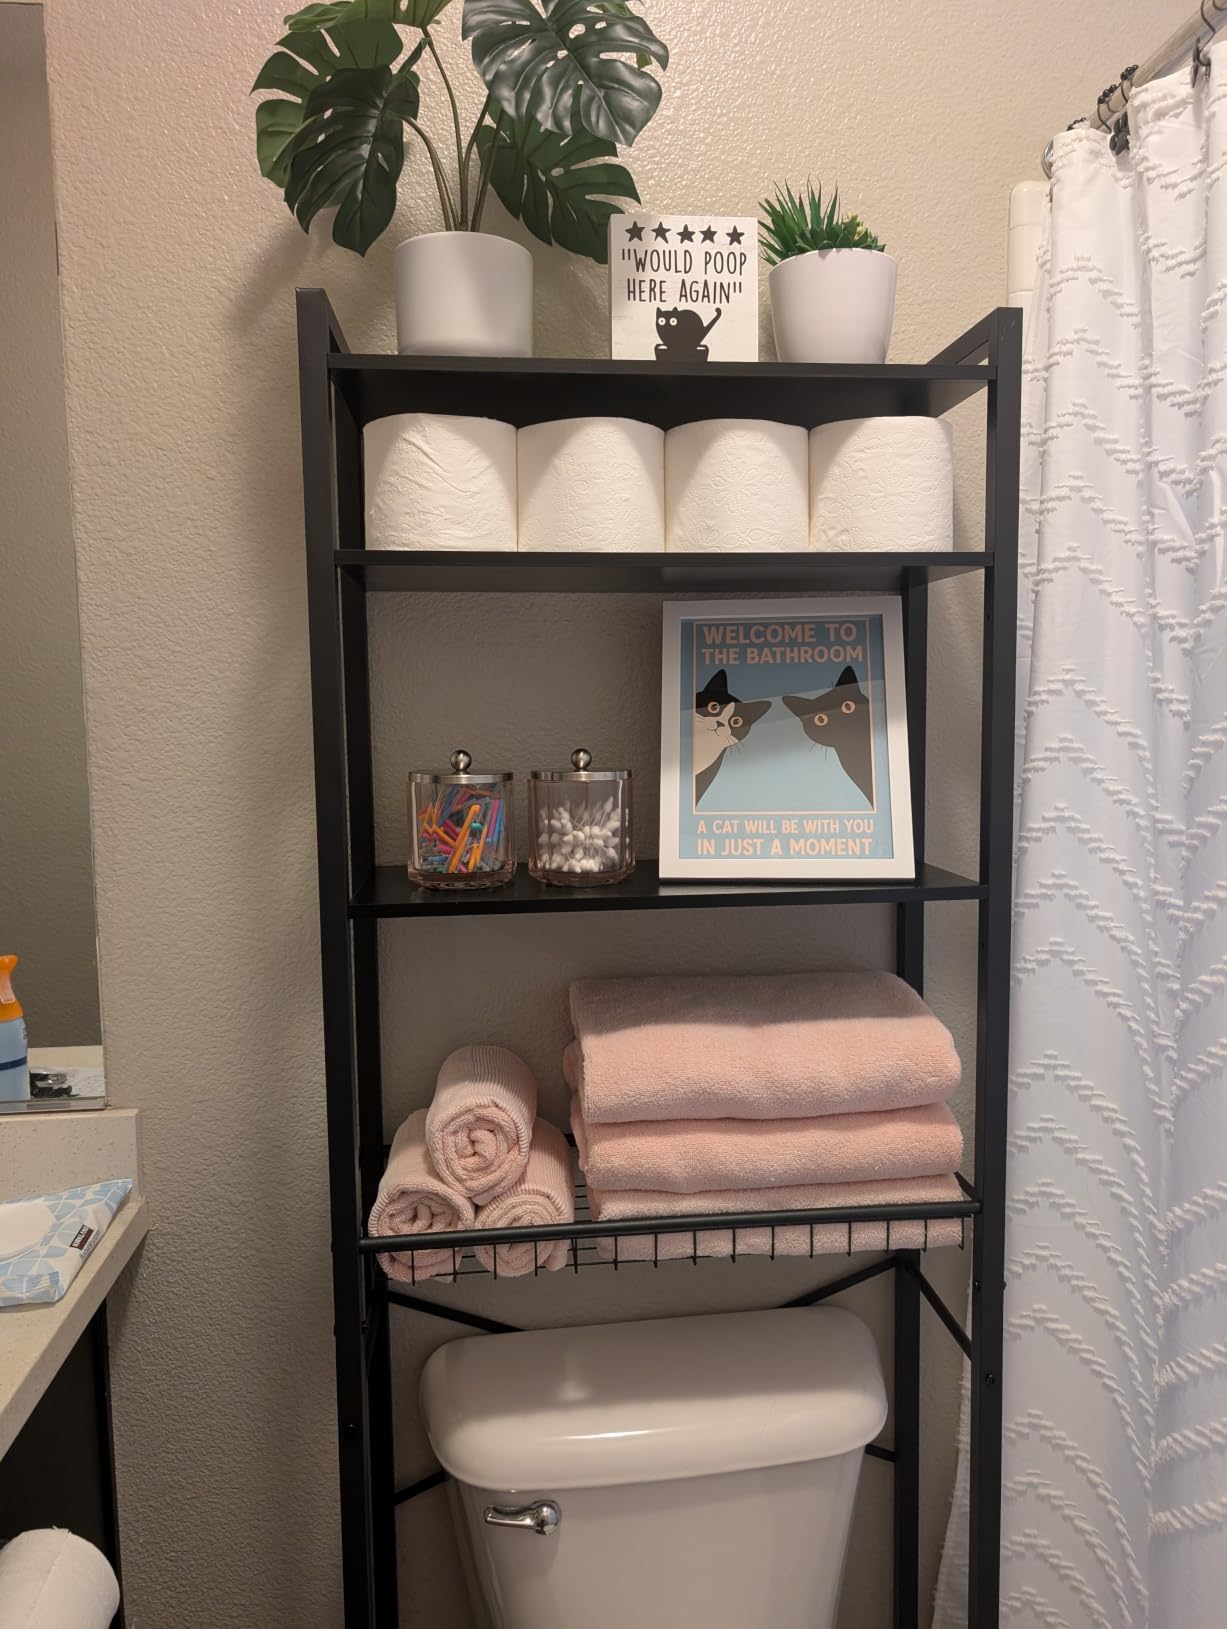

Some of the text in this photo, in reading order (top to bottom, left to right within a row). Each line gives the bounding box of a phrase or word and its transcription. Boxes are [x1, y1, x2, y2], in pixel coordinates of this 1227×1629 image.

[622, 248, 747, 276] "WOULD POOP
[627, 278, 742, 304] HERE AGAIN"
[703, 623, 857, 645] WELCOME TO
[702, 645, 863, 665] THE BATHROOM
[697, 819, 874, 833] A CAT WILL BE WITH YOU
[697, 838, 873, 856] IN JUST A MOMENT
